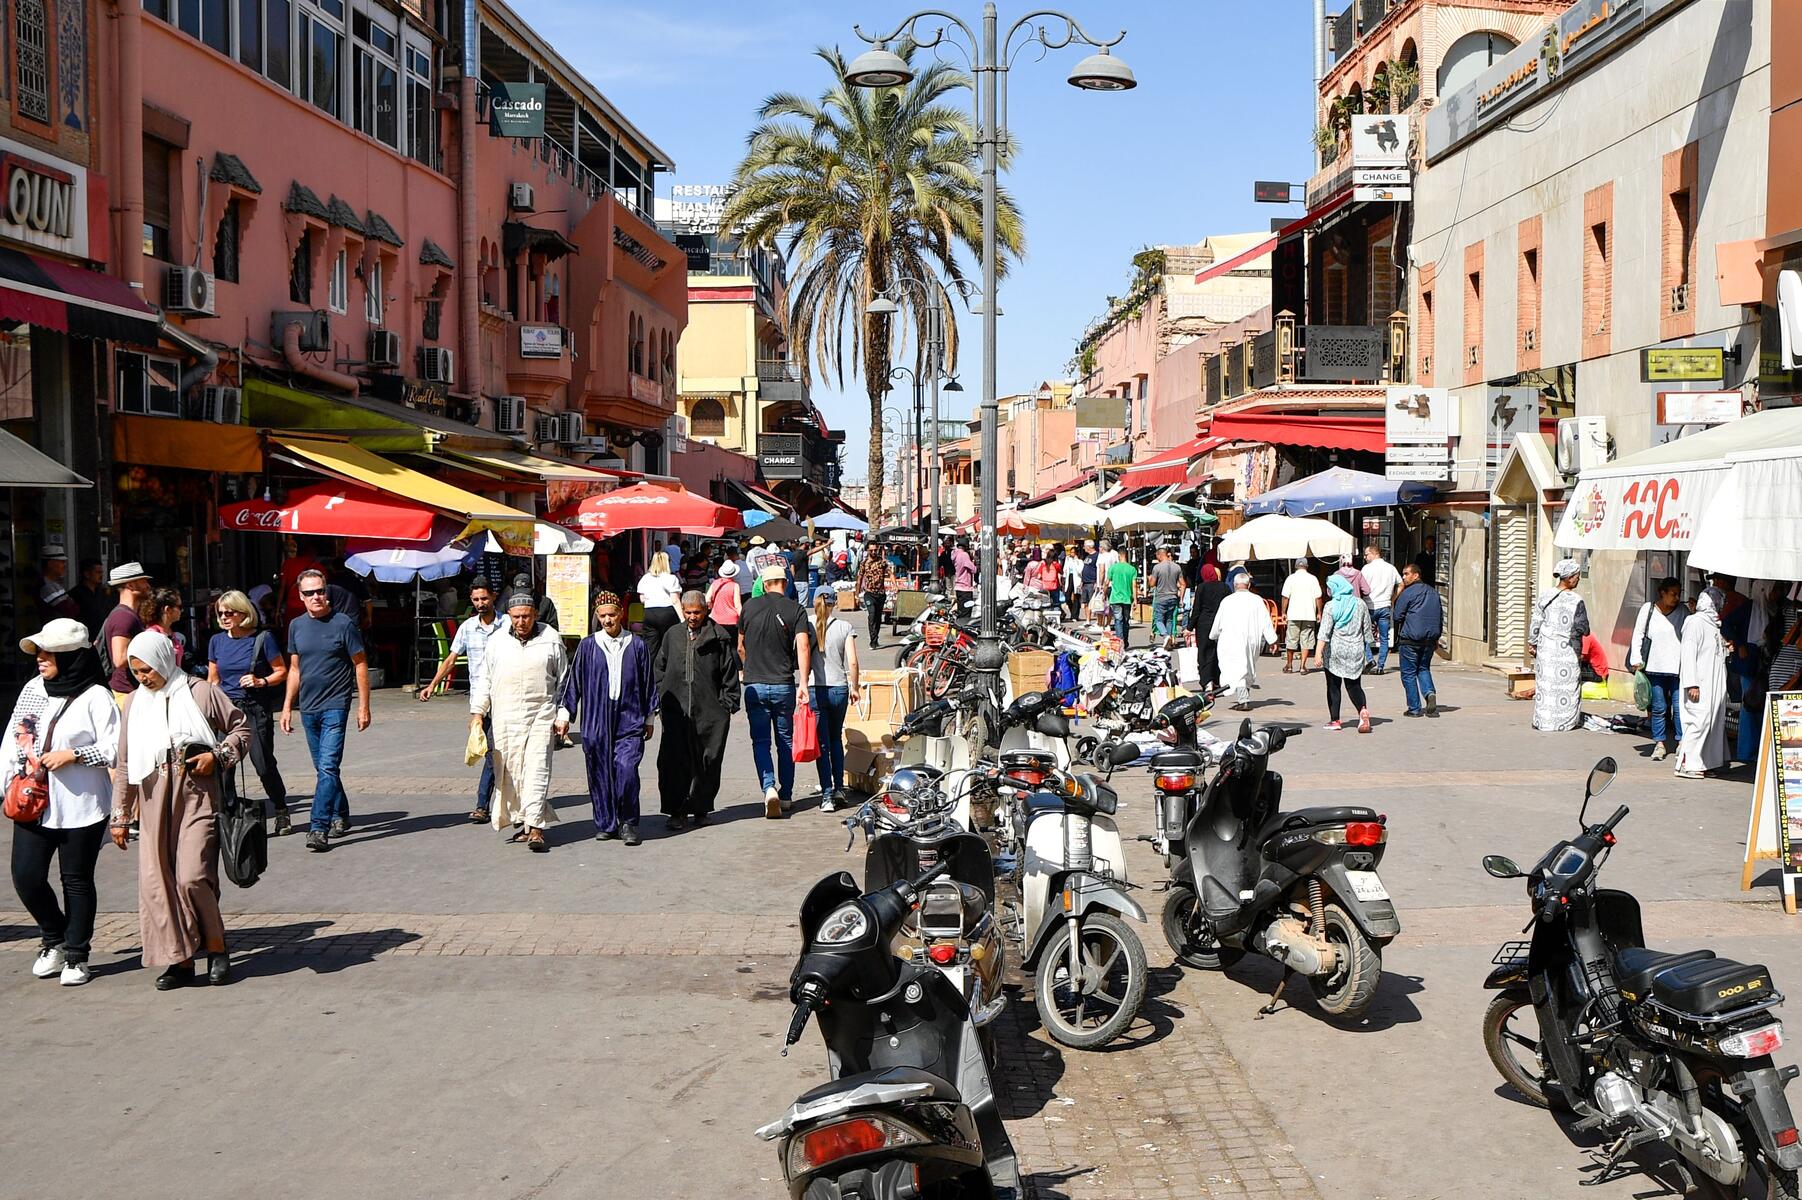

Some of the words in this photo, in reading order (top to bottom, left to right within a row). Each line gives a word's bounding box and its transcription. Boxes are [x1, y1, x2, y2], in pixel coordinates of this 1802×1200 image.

[492, 97, 542, 111] Cascado
[1362, 173, 1403, 181] CHANGE
[673, 184, 730, 197] RESTAU
[828, 465, 836, 497] HOTL
